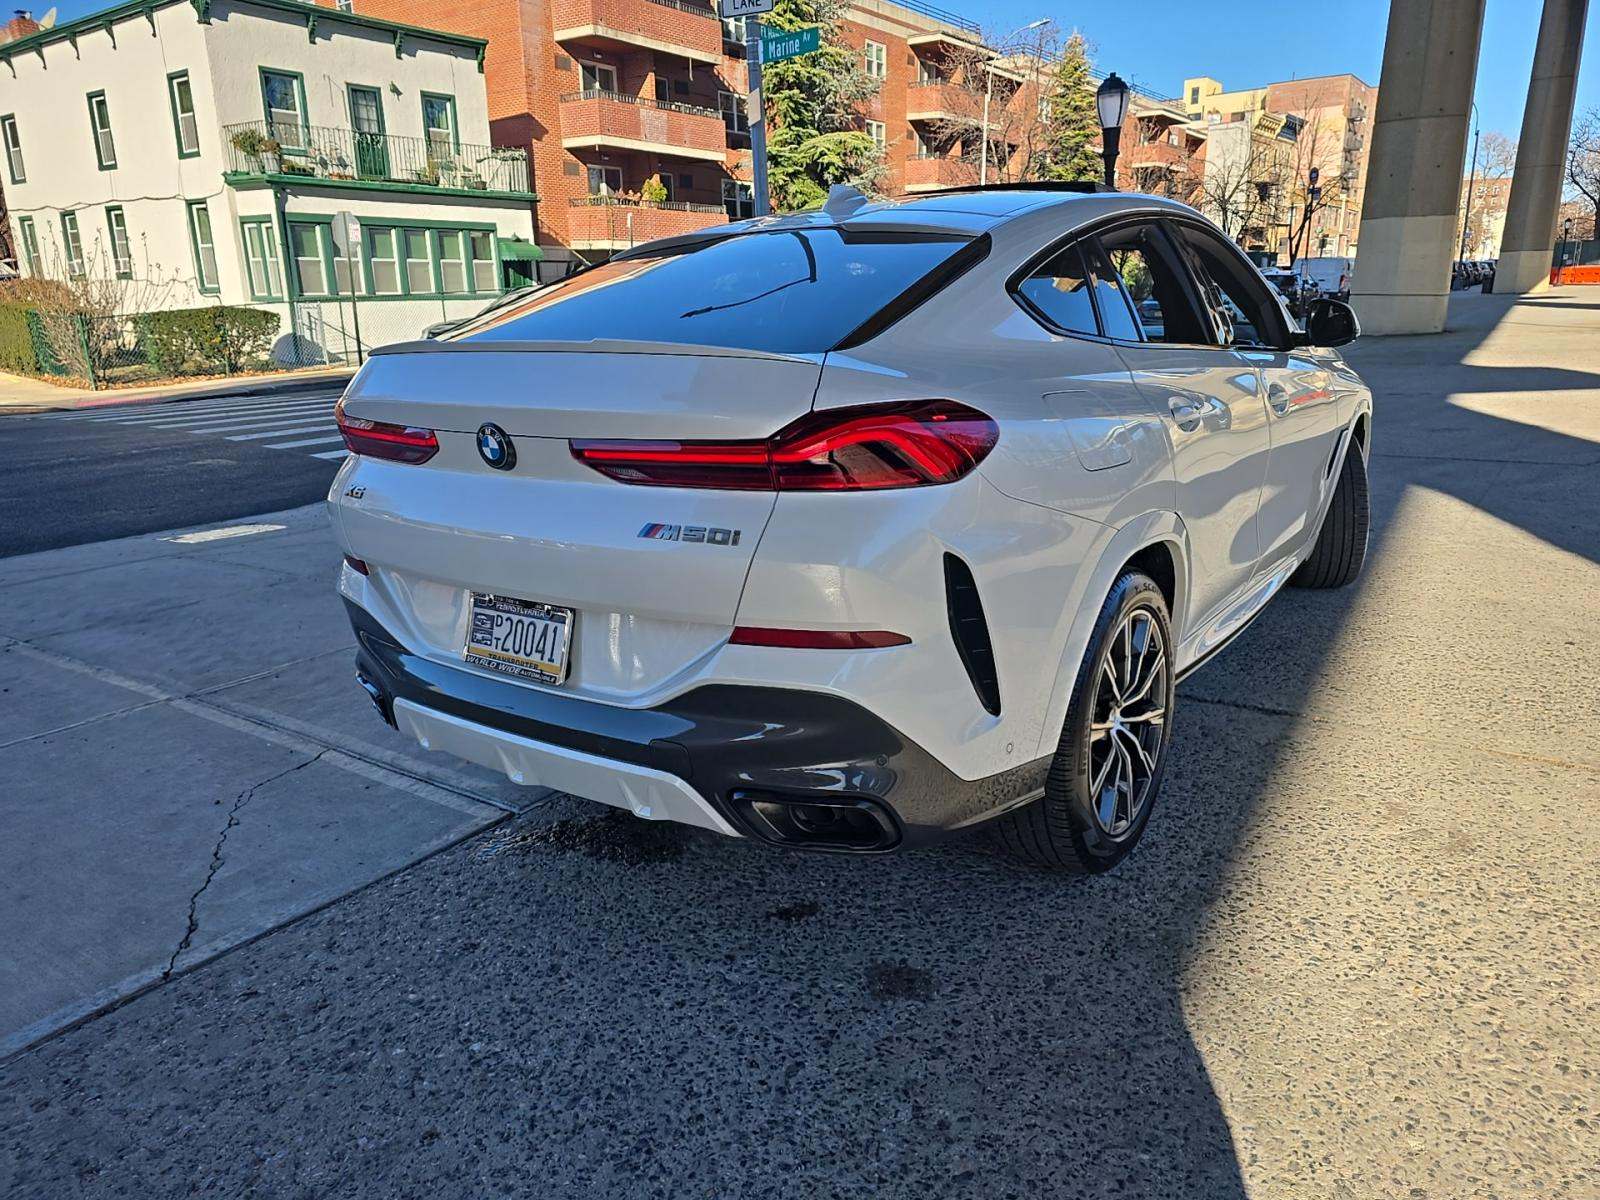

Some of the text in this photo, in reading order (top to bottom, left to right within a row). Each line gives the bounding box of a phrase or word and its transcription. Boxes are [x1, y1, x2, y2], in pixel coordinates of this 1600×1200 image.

[733, 0, 762, 10] LANE
[768, 37, 800, 59] Marine
[479, 428, 501, 441] BMW
[495, 603, 545, 617] PENNSYLVANIA
[501, 617, 558, 663] 20041
[498, 663, 521, 675] WIDE
